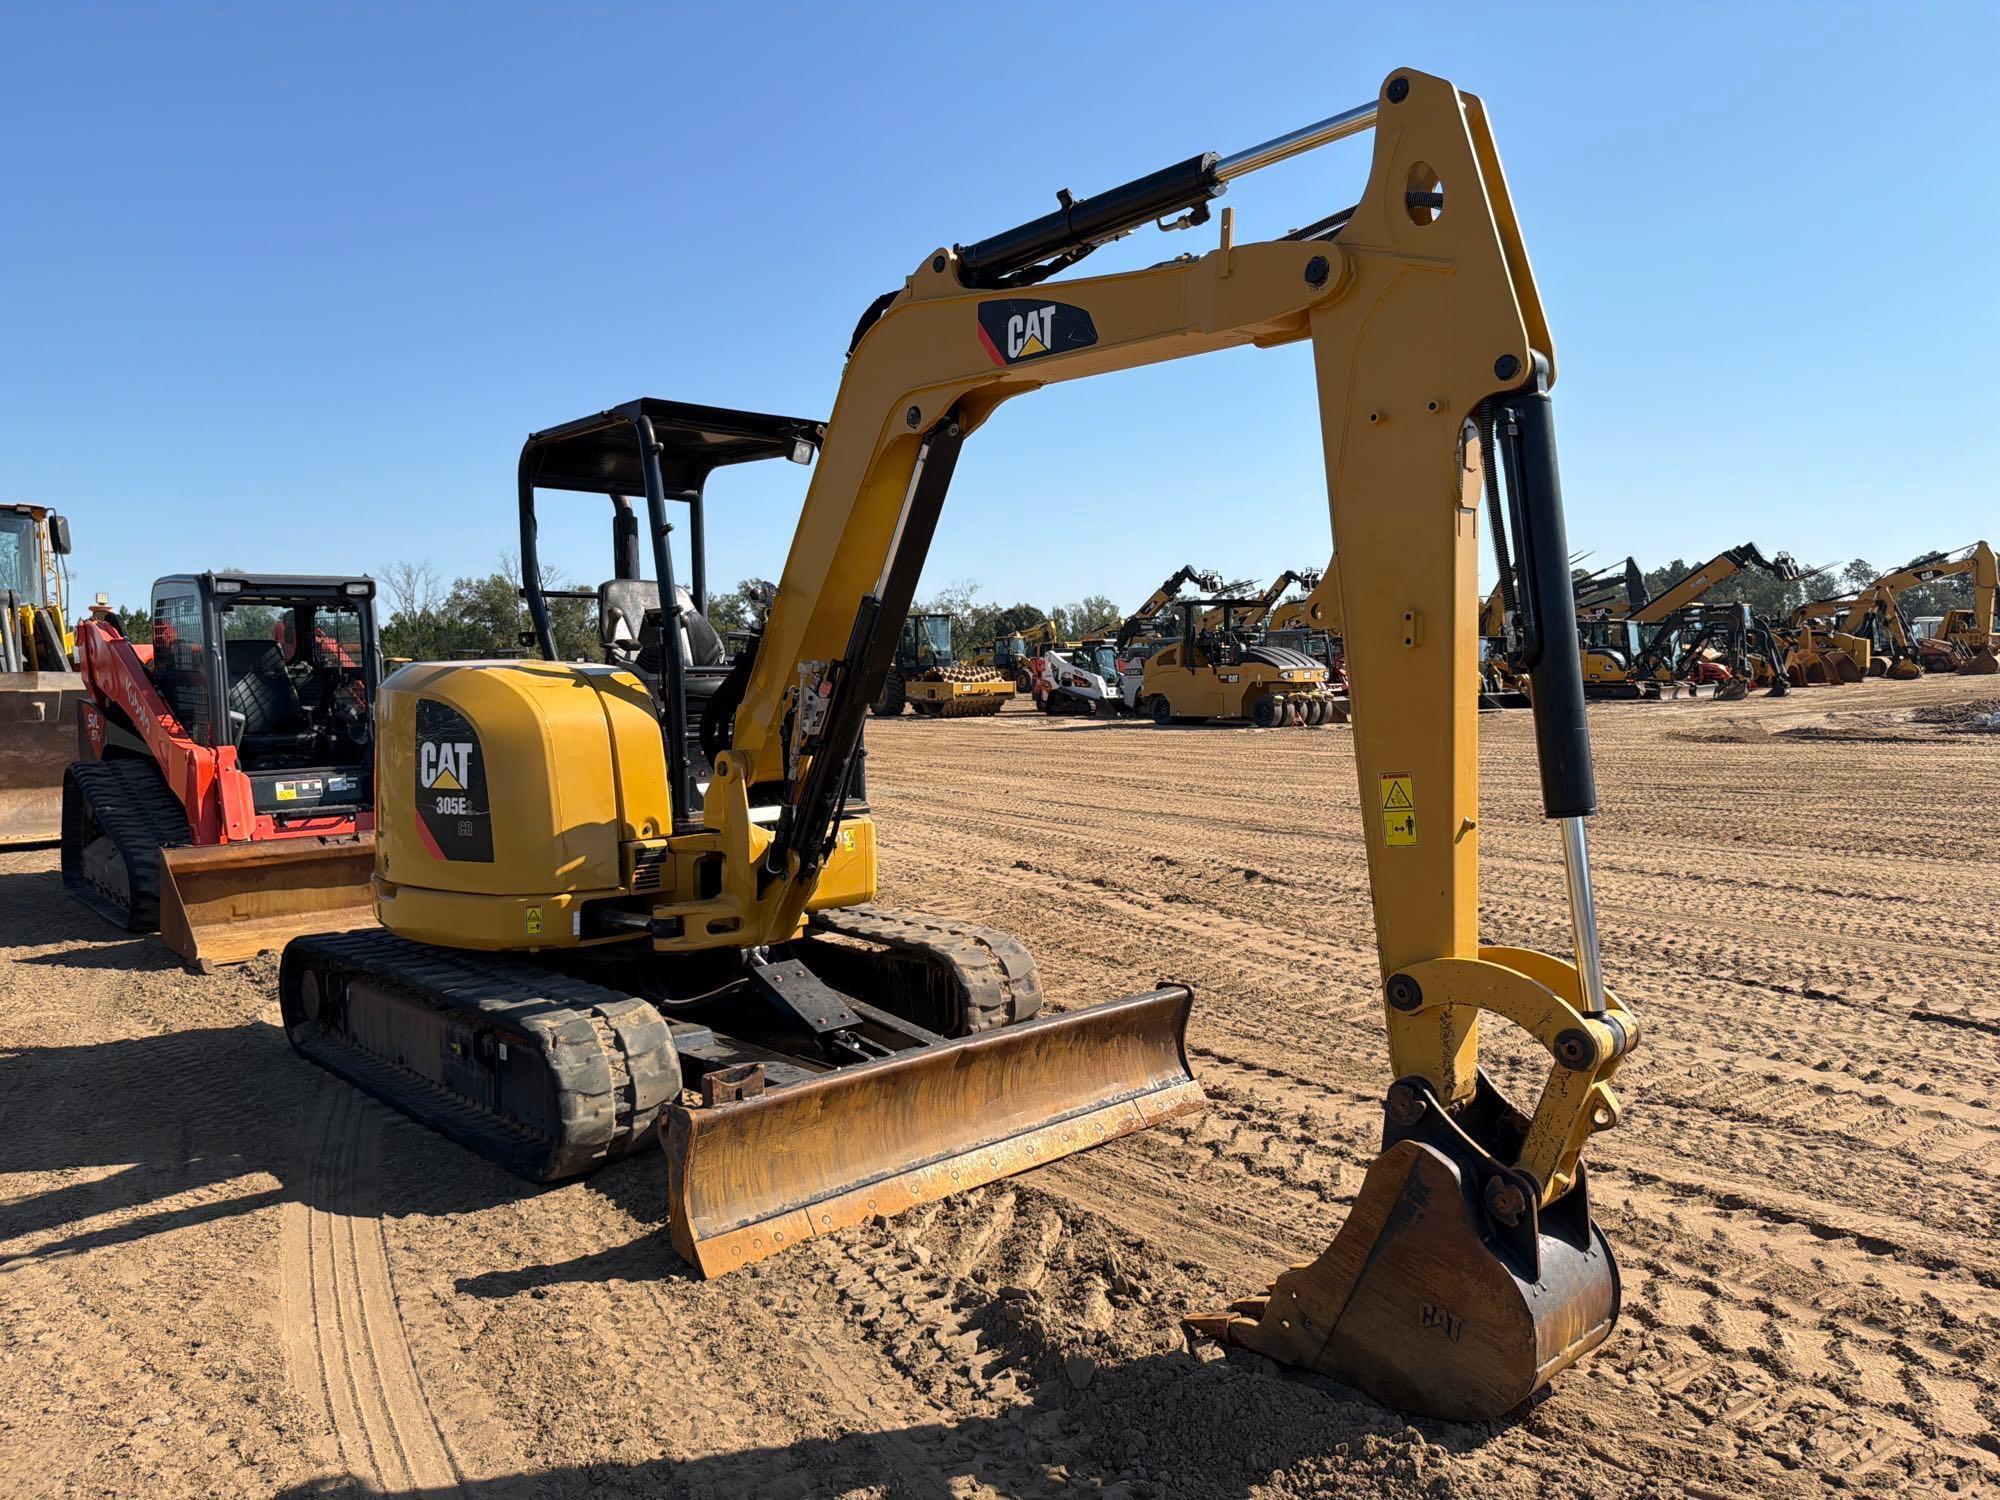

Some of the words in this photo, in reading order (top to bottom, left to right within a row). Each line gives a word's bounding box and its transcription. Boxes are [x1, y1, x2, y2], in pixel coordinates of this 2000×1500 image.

[1007, 305, 1056, 358] CAT
[1921, 571, 1934, 580] CAT
[421, 741, 473, 789] CAT
[457, 820, 473, 836] CR
